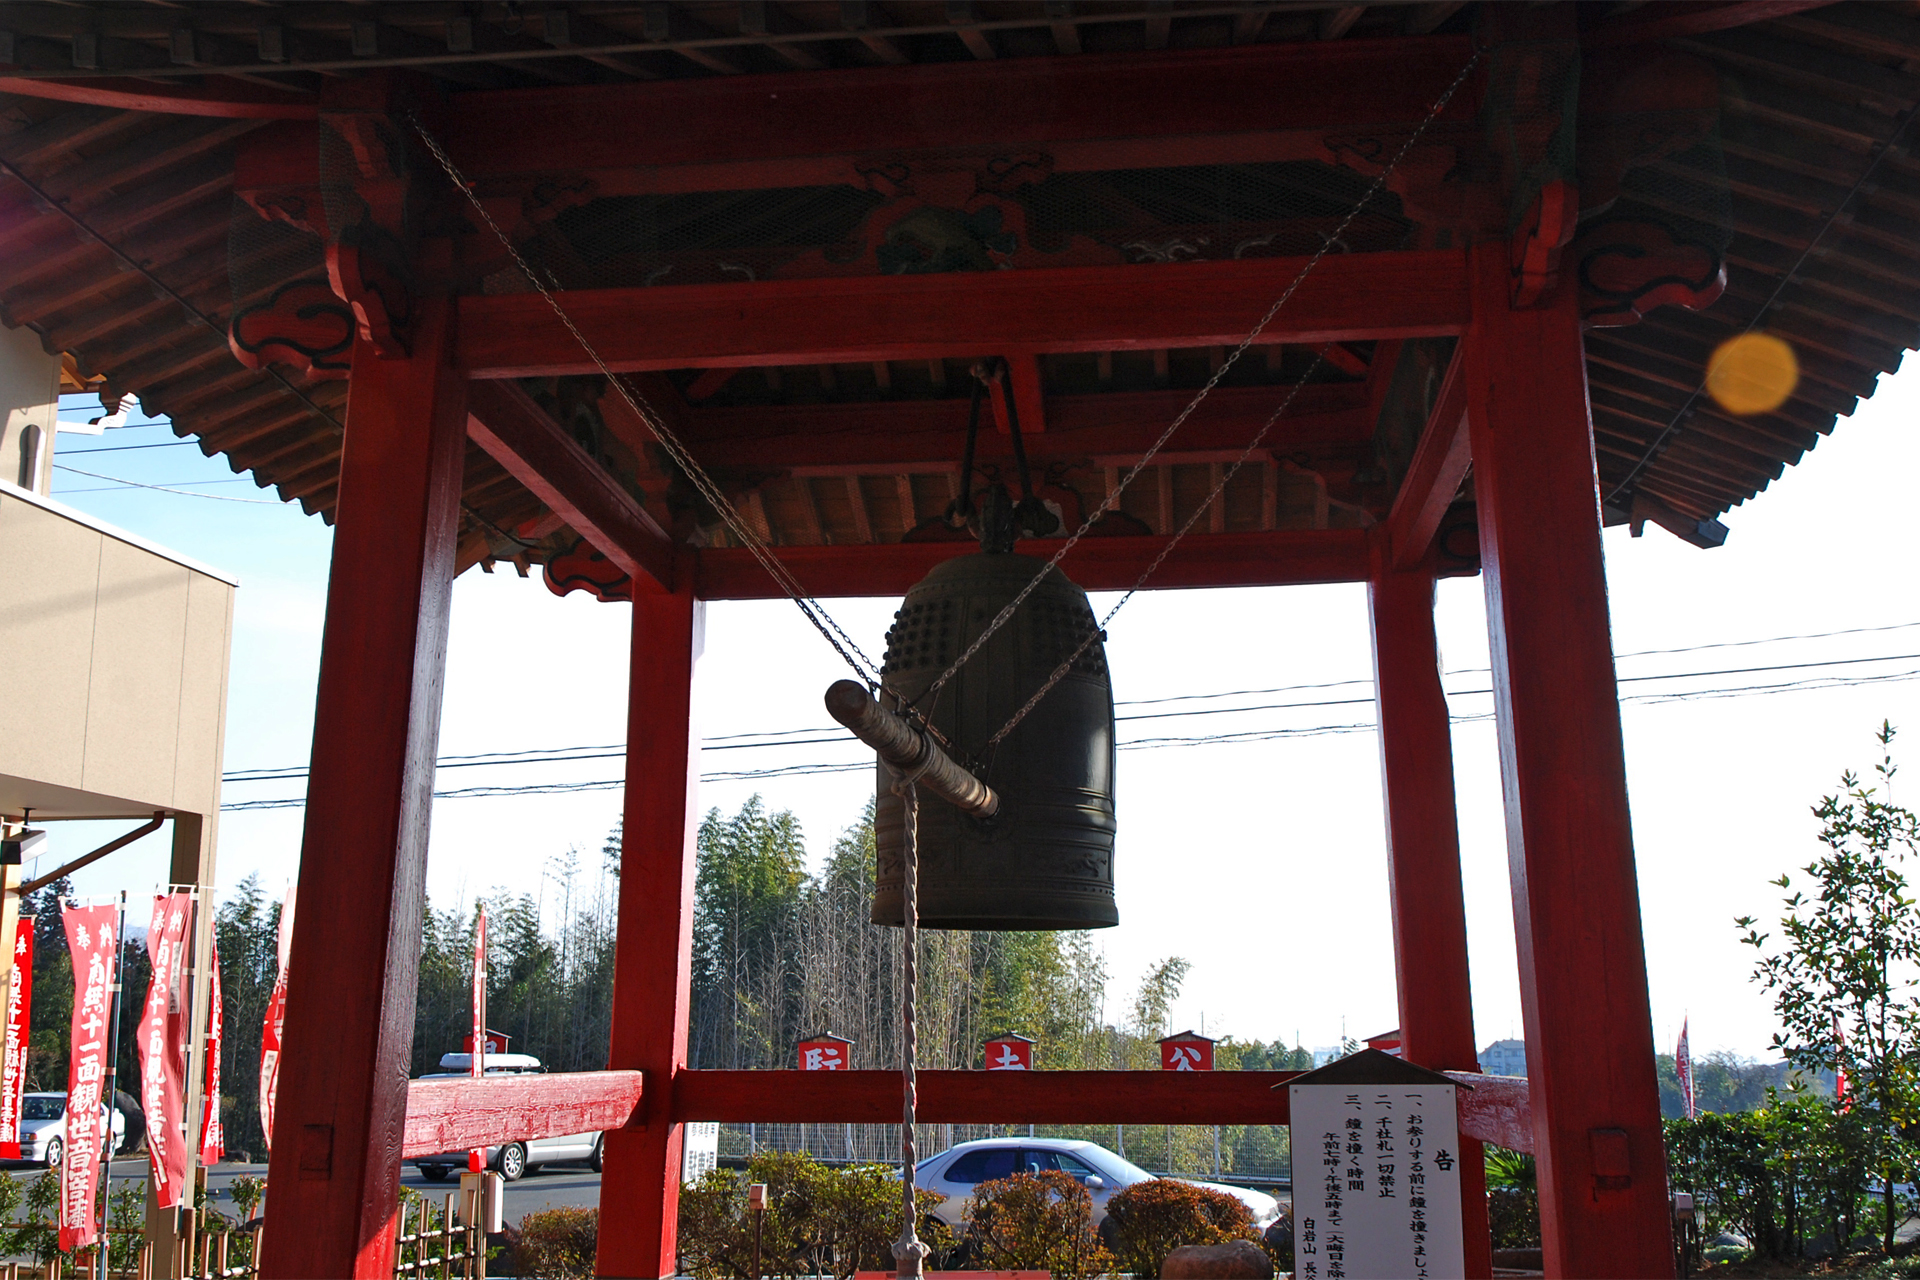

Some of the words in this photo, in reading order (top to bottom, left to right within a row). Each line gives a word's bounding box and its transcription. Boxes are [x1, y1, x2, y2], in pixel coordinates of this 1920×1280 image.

[15, 934, 27, 956] 奉
[1374, 1094, 1396, 1199] 二、千社札一切禁止
[1433, 1149, 1456, 1172] 告
[1404, 1093, 1429, 1280] 一、お参りする前に鐘を撞きましょ
[1302, 1217, 1317, 1255] 白岩山
